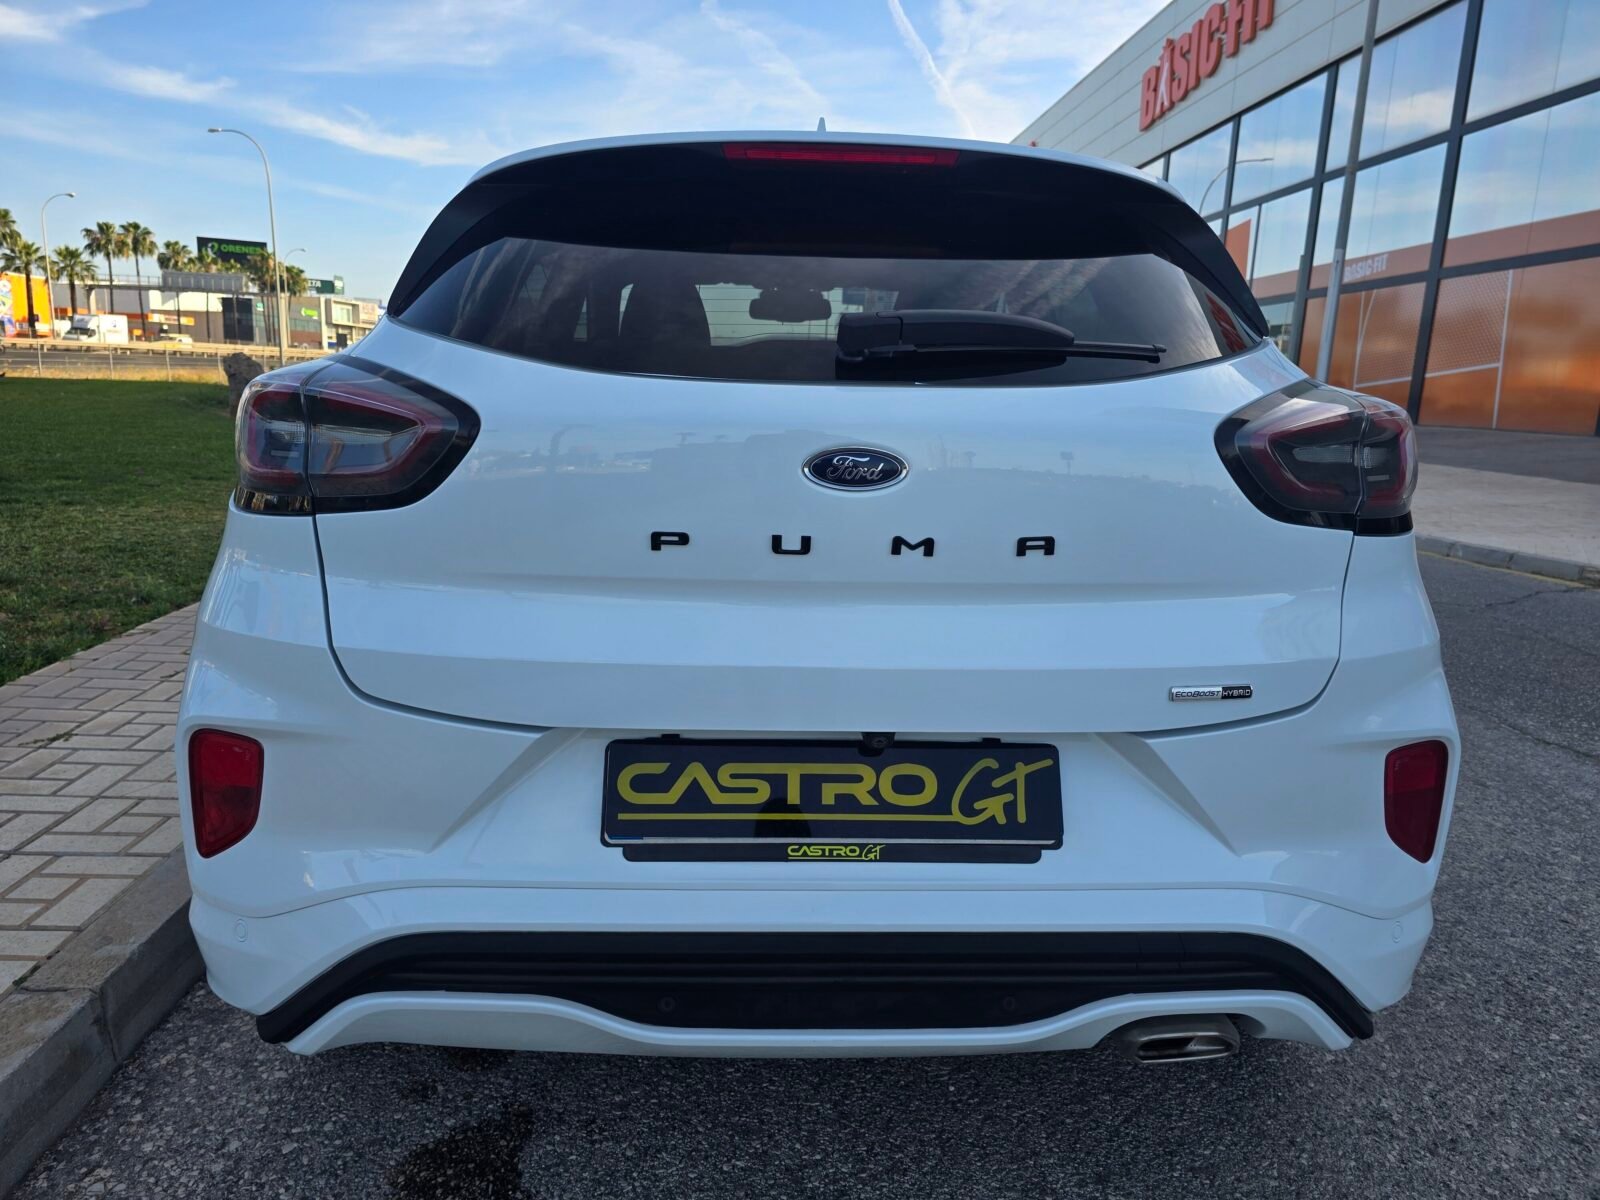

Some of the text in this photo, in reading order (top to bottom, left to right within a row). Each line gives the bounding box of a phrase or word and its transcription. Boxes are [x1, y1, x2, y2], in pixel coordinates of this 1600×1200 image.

[826, 455, 883, 481] Ford
[650, 531, 1056, 557] PUMA
[1222, 689, 1251, 697] HYBRID
[616, 757, 1053, 825] CASTRO GT
[787, 844, 886, 860] CASTRO GT
